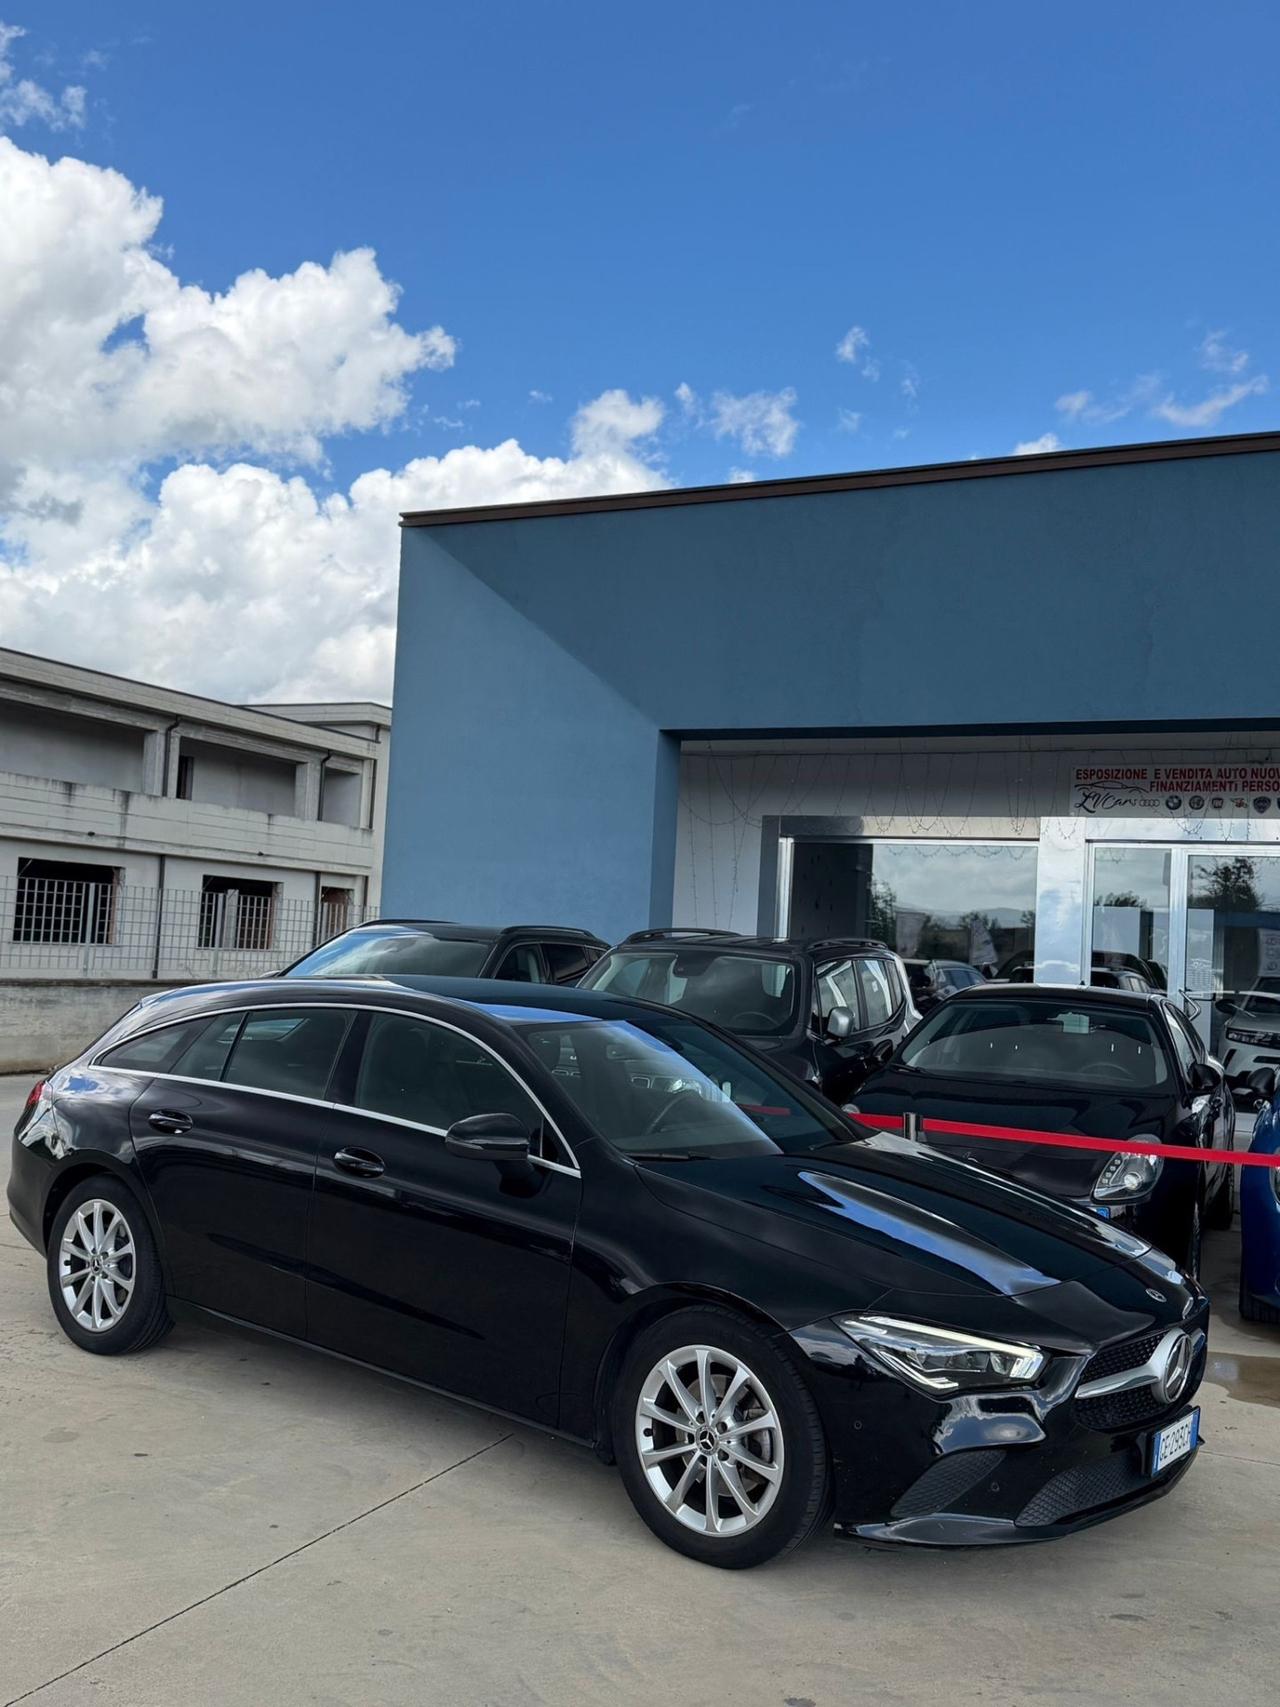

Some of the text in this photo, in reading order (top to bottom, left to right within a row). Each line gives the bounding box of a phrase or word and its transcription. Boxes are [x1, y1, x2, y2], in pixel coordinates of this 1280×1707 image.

[1076, 768, 1148, 780] ESPOSIZIONE
[1154, 768, 1161, 780] E
[1165, 768, 1213, 779] VENDITA
[1217, 767, 1247, 779] AUTO
